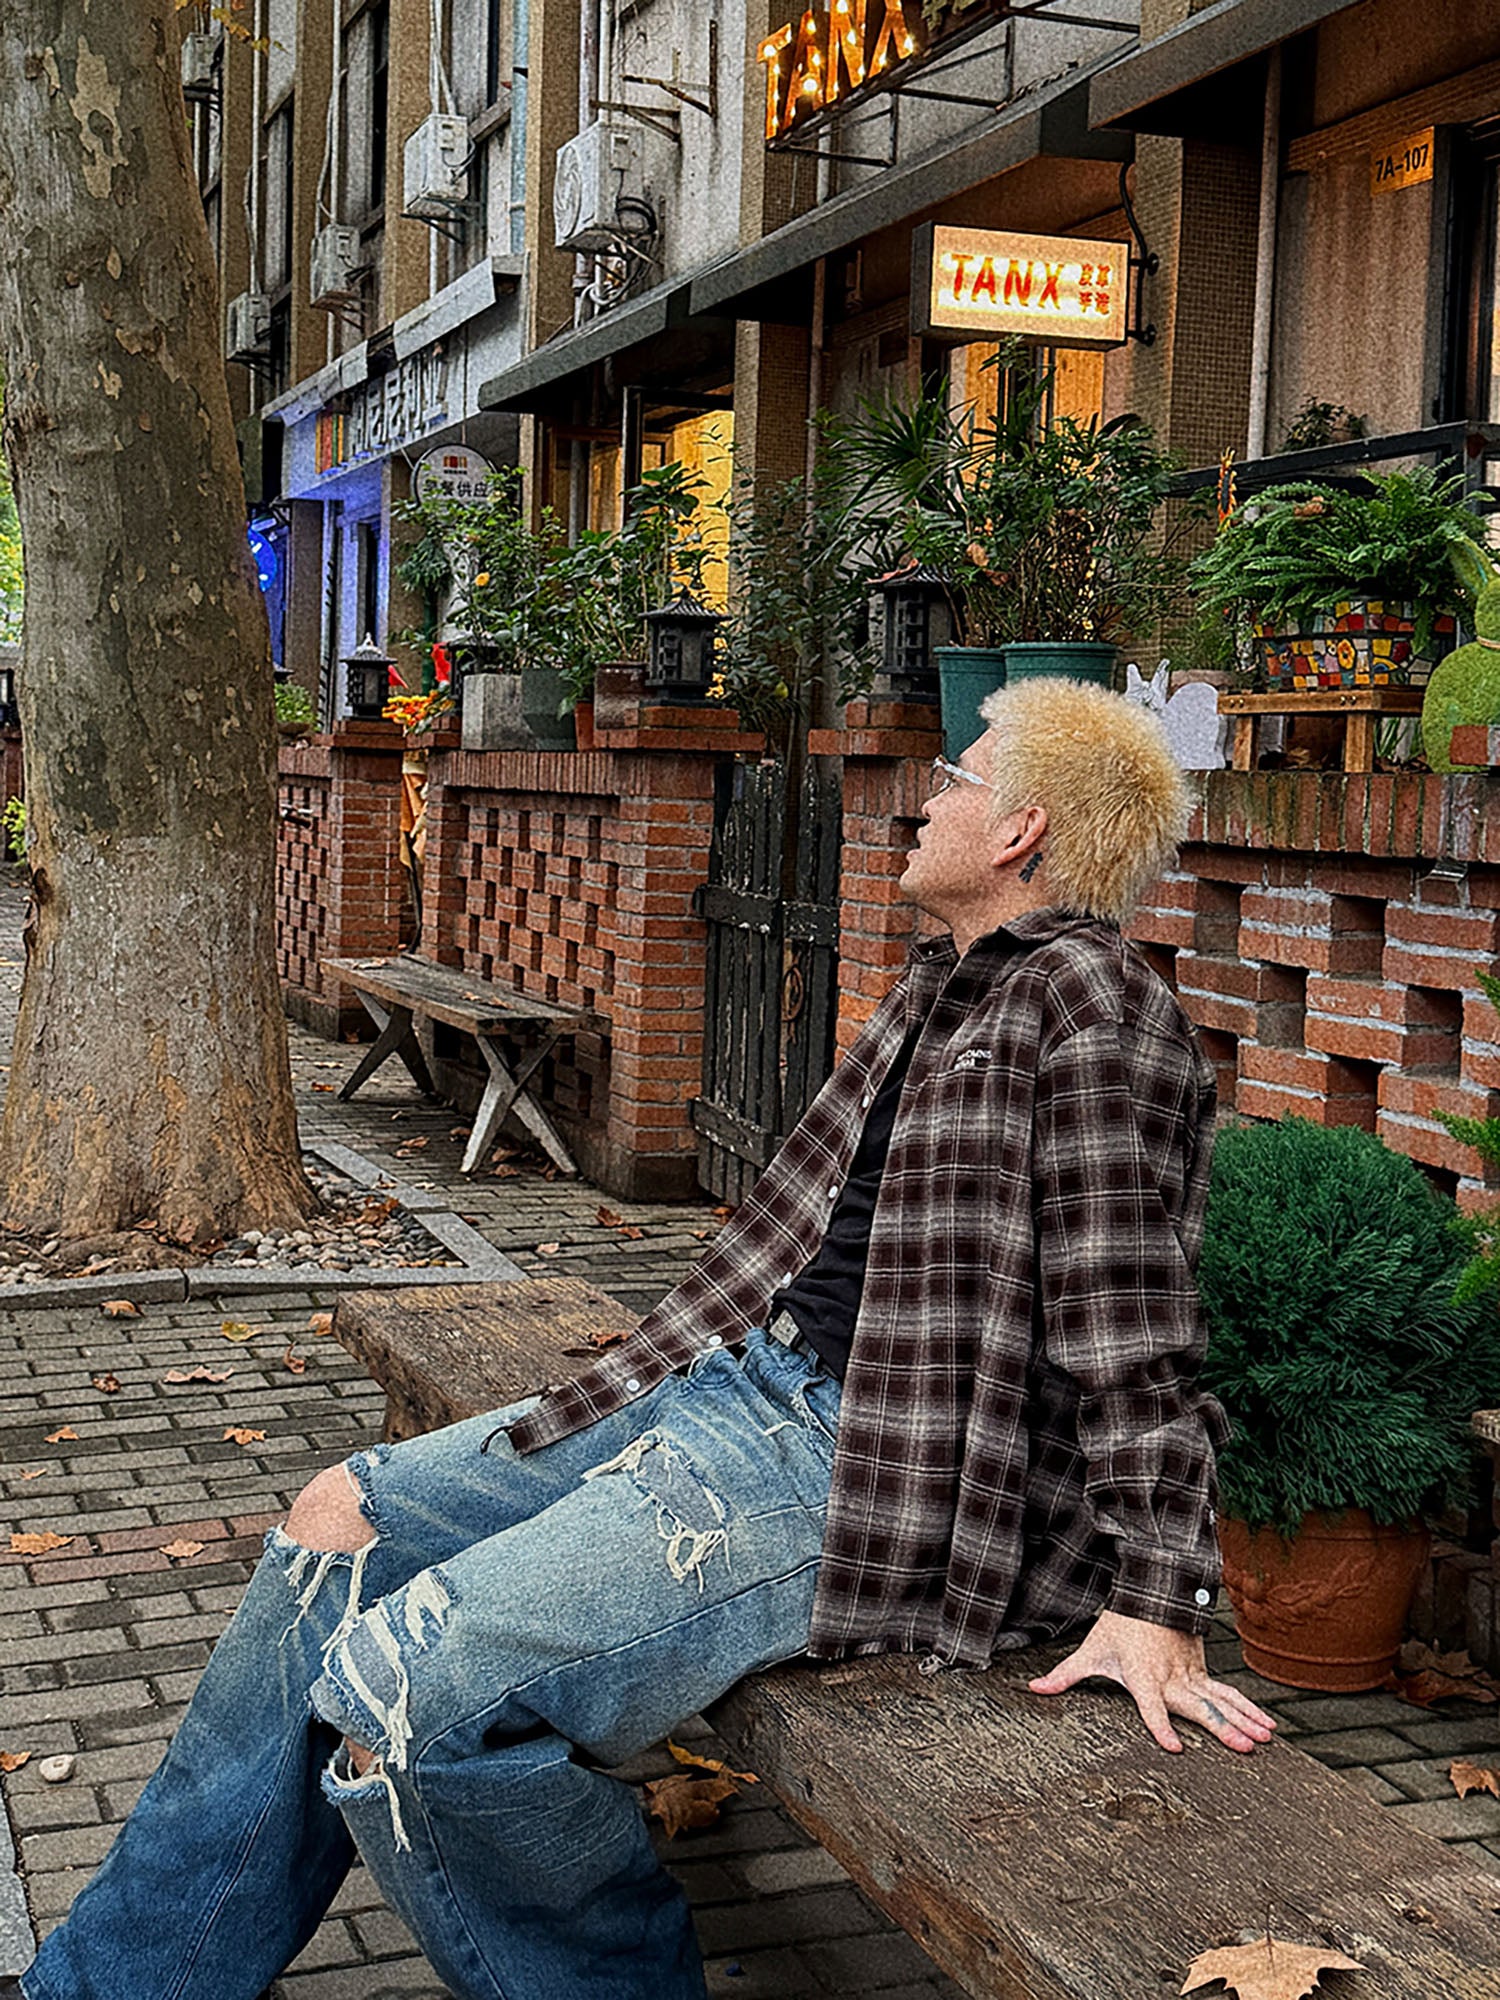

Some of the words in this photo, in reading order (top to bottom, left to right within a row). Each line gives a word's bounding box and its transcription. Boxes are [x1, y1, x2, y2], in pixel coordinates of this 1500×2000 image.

[757, 0, 914, 140] TANX
[1375, 144, 1429, 182] 7A-107
[950, 253, 1065, 310] TANX
